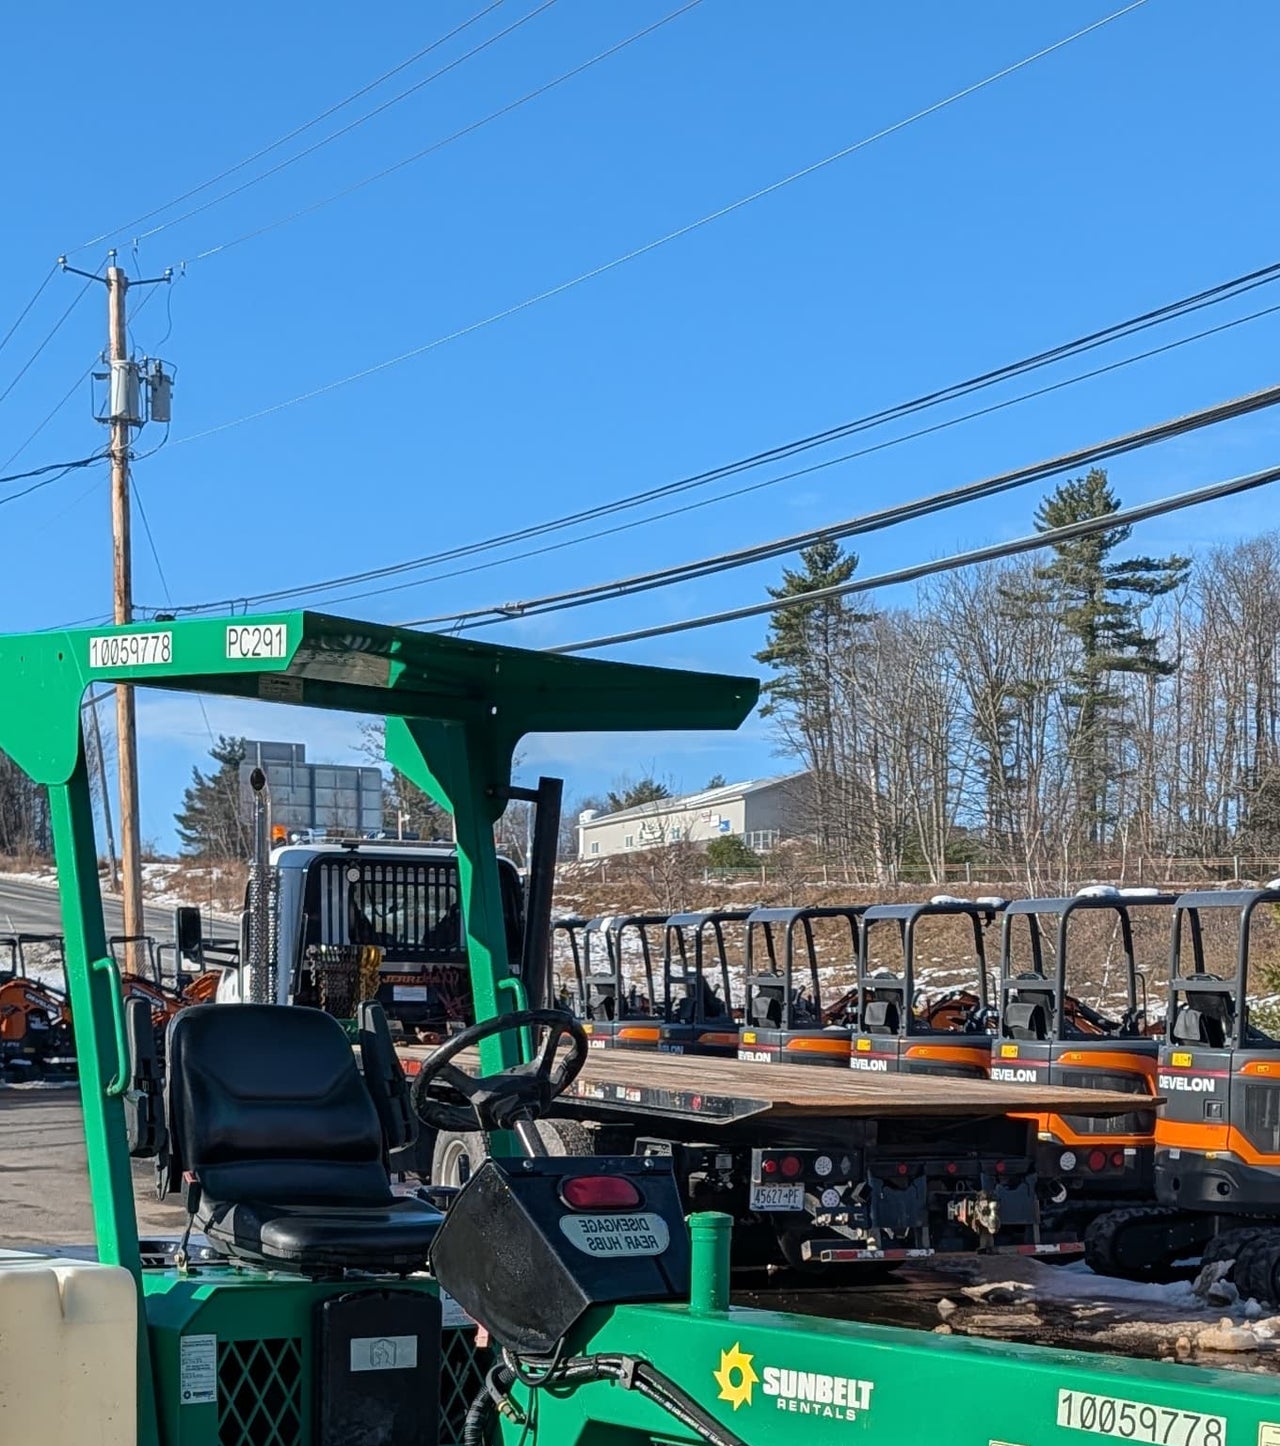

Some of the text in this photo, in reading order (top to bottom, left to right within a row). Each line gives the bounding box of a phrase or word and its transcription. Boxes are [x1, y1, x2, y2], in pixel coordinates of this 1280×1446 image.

[91, 634, 171, 666] 10059778
[227, 627, 284, 657] PC291
[1158, 1075, 1215, 1093] DEVELON
[762, 1366, 875, 1410] SUNBELT
[776, 1398, 857, 1422] RENTALS
